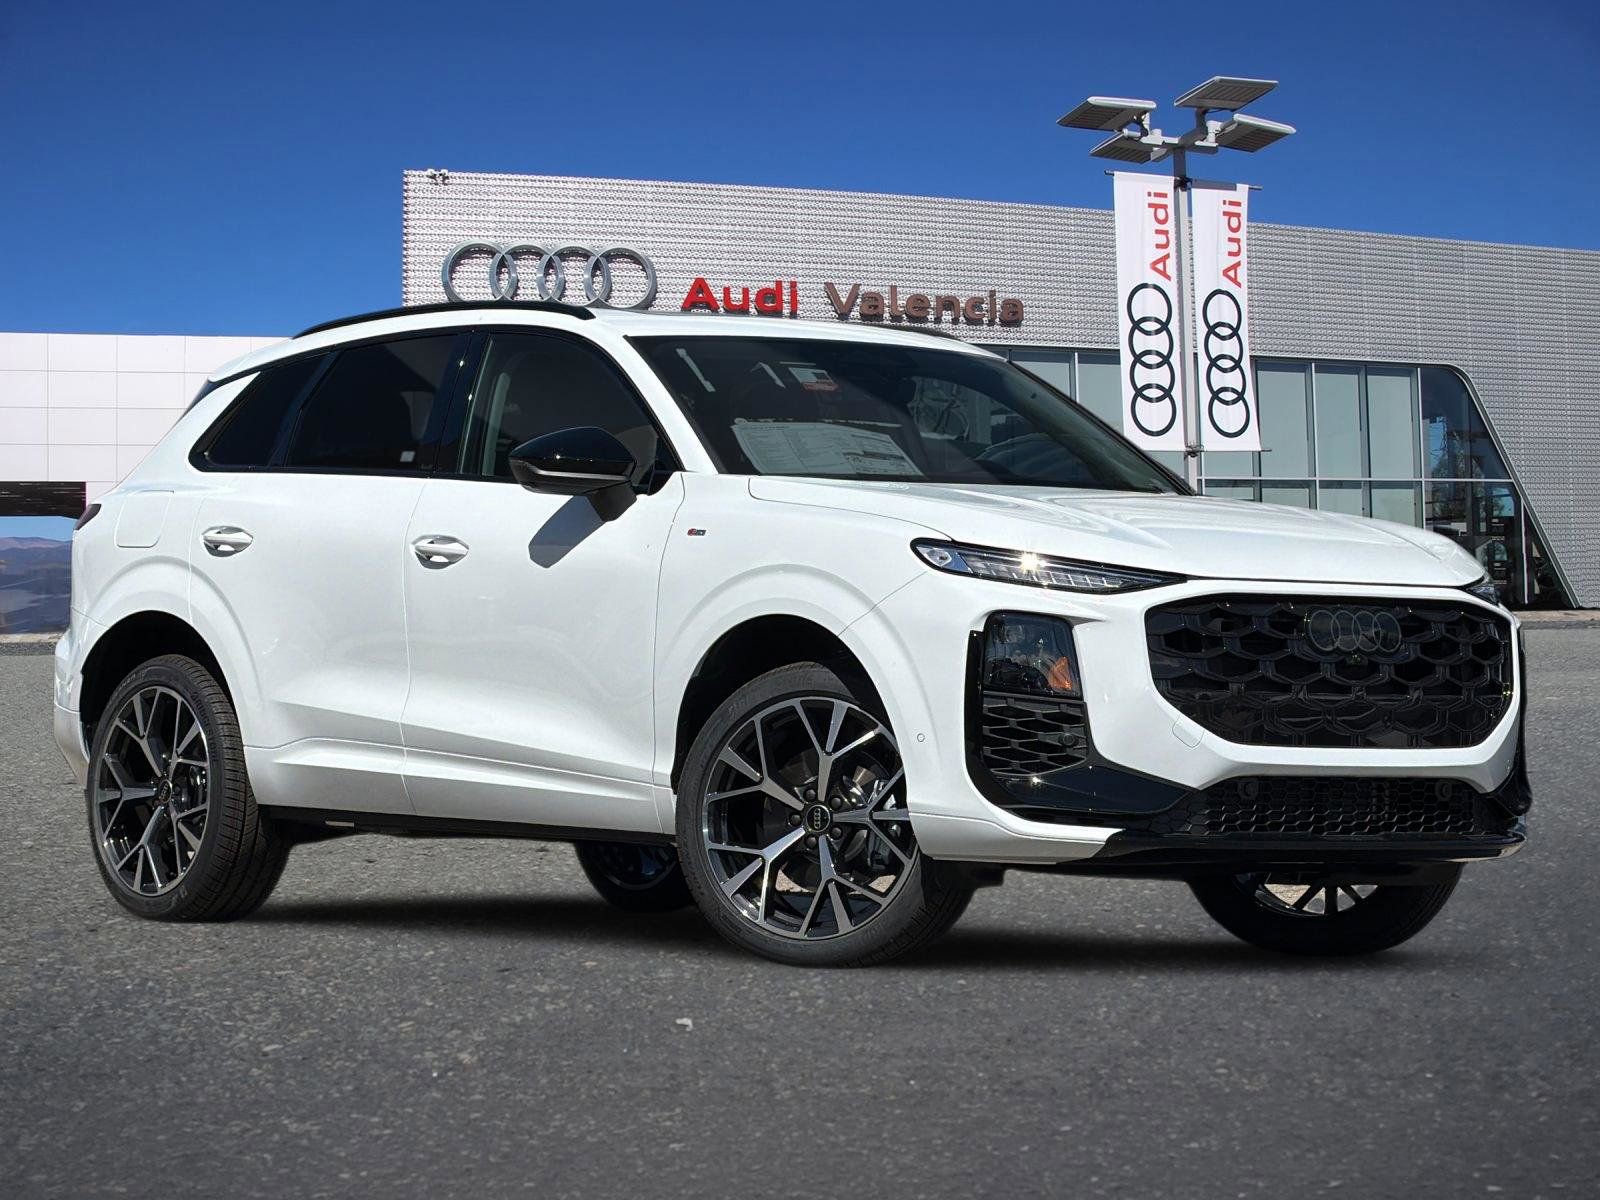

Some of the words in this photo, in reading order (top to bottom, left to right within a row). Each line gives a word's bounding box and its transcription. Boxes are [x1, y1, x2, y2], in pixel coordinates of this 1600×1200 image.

[1147, 191, 1171, 281] Audi
[1222, 200, 1242, 288] Audi
[680, 276, 799, 314] Audi
[824, 281, 1025, 326] Valencia
